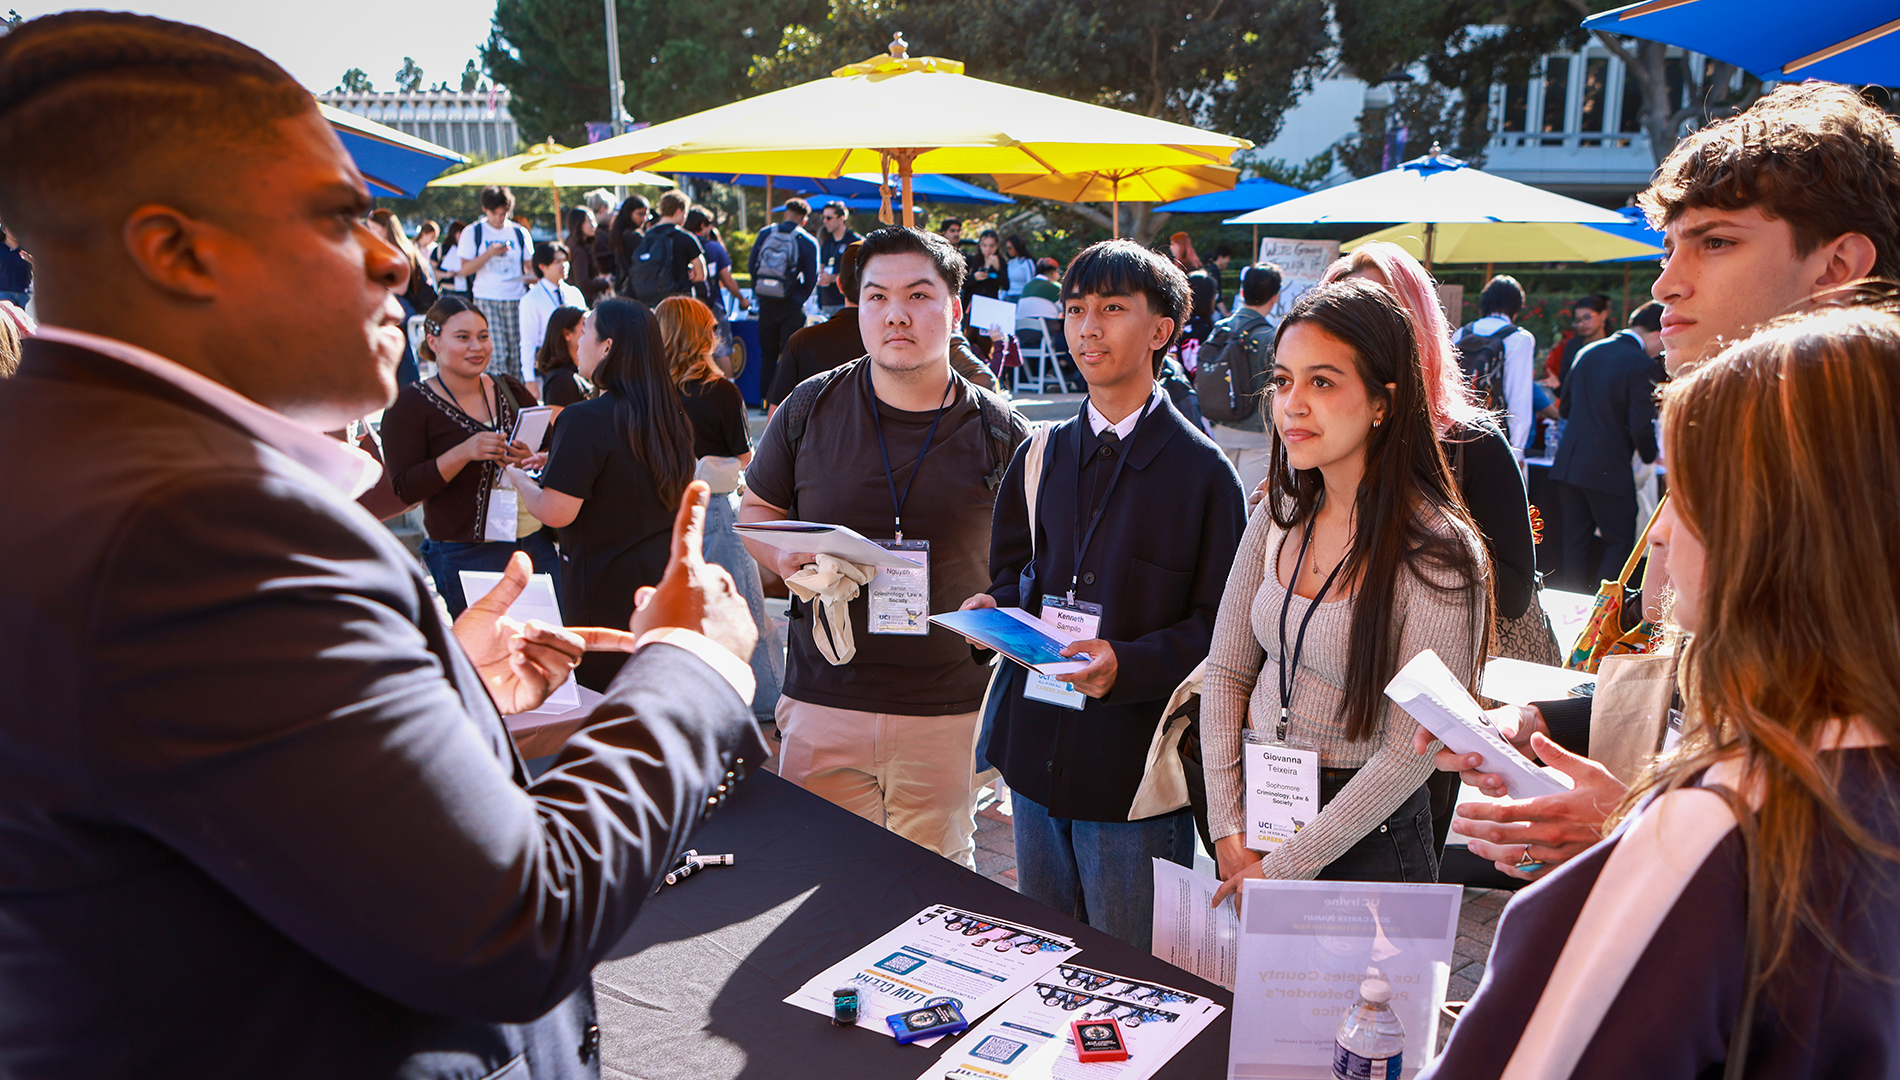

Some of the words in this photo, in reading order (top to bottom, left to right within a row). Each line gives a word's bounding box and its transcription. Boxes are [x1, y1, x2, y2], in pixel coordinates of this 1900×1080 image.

[1057, 612, 1084, 623] Kenneth
[1057, 622, 1081, 633] Sampilo
[1263, 752, 1302, 764] Giovanna
[1267, 764, 1297, 775] Teixeira
[1266, 781, 1300, 792] Sophomore
[1257, 789, 1291, 800] Criminology,
[1272, 798, 1293, 807] Society
[1258, 821, 1272, 829] UCI
[889, 987, 926, 1004] LAW
